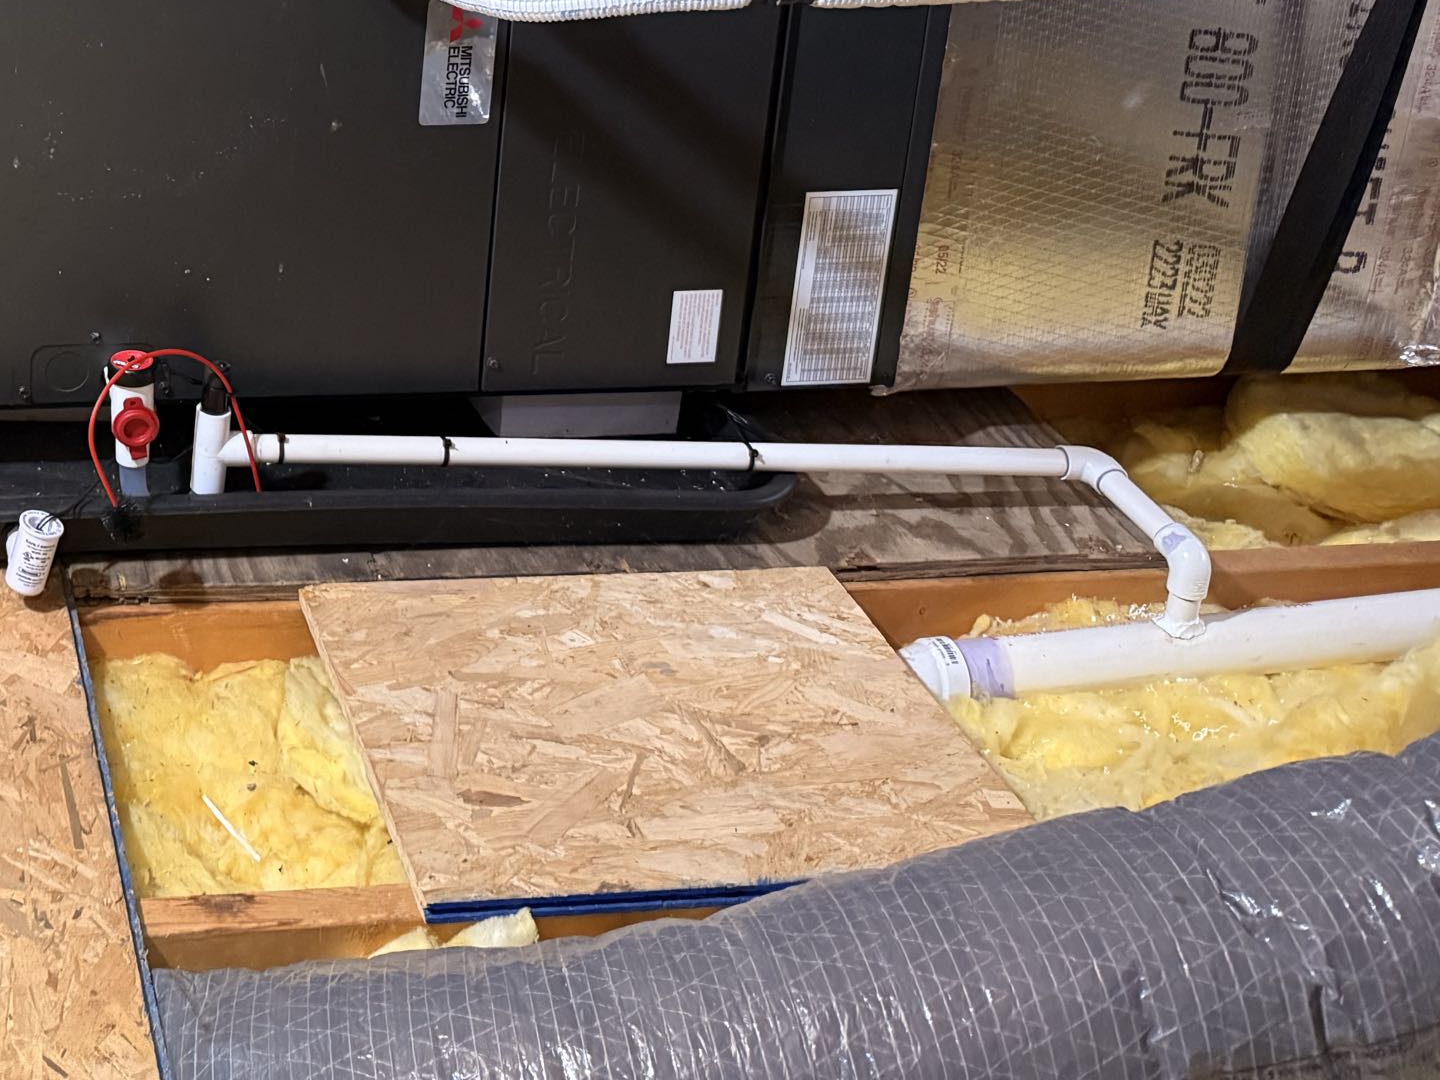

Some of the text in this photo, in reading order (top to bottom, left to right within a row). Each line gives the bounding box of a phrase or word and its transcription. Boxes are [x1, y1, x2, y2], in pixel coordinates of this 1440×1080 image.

[444, 46, 460, 110] ELECTRIC
[455, 45, 473, 118] MITSUBISHI
[1160, 26, 1259, 209] 800-FRK
